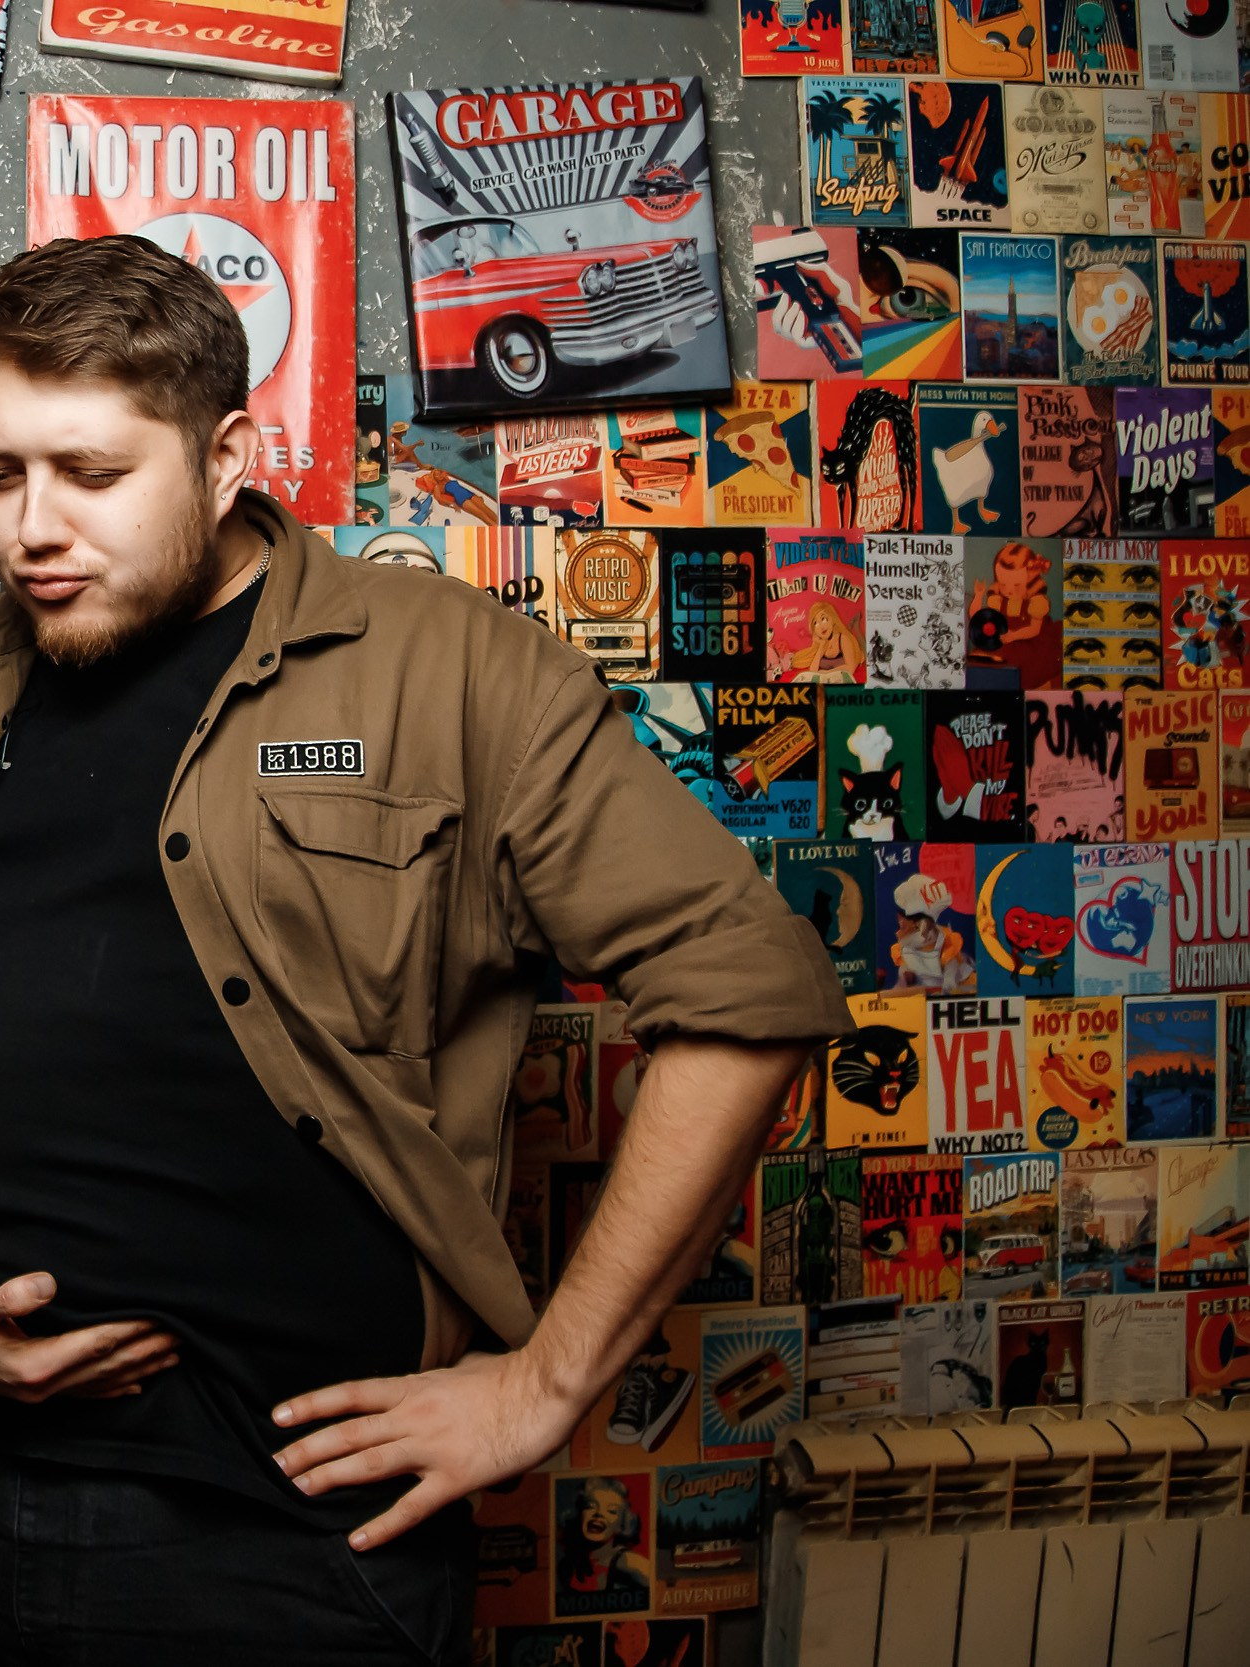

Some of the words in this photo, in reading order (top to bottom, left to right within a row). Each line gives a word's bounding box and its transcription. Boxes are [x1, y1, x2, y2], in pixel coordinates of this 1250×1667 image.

[77, 7, 335, 57] Gasoline
[1050, 72, 1090, 84] WHO
[1097, 73, 1139, 86] WAIT
[442, 86, 676, 145] GARAGE
[50, 122, 236, 200] MOTOR
[255, 127, 336, 202] OIL
[472, 172, 516, 191] SERVICE
[523, 165, 546, 181] CAR
[547, 159, 577, 178] WASH
[584, 152, 612, 168] AUTO
[614, 144, 646, 163] PARTS
[820, 176, 899, 216] Surfing
[937, 209, 991, 222] SPACE
[966, 242, 985, 259] SAN
[989, 241, 1052, 260] FRANCISCO
[1065, 240, 1151, 269] Breakfast
[1170, 363, 1215, 380] PRIVATE
[1222, 363, 1249, 380] TOUR
[920, 390, 943, 400] MESS
[946, 390, 968, 400] WITH
[971, 391, 987, 400] THE
[1117, 405, 1211, 456] Violent
[1131, 450, 1197, 494] Days
[723, 485, 737, 495] FOR
[723, 495, 795, 513] PRESIDENT
[867, 538, 900, 555] Pale
[900, 538, 953, 555] Hands
[585, 558, 630, 579] RETRO
[585, 581, 631, 601] MUSIC
[1177, 663, 1243, 689] Cats
[718, 687, 811, 706] KODAK
[880, 693, 920, 705] CAFE
[718, 708, 776, 726] FILM
[950, 713, 991, 738] PLEASE
[1128, 693, 1214, 741] MUSIC
[962, 724, 1007, 749] DON'T
[268, 747, 285, 770] EST
[290, 745, 355, 769] 1988
[967, 740, 1013, 781] KILL
[782, 800, 811, 814] V620
[789, 816, 810, 830] 620
[932, 1000, 1020, 1029] HELL
[1033, 1012, 1071, 1037] HOT
[1078, 1009, 1118, 1034] DOG
[1135, 1011, 1165, 1024] NEW
[1172, 1009, 1209, 1022] YORK
[934, 1030, 1023, 1132] YEA
[935, 1137, 977, 1154] WHY
[981, 1133, 1023, 1152] NOT?
[1064, 1150, 1096, 1168] LAS
[1099, 1148, 1157, 1166] VEGAS
[864, 1170, 930, 1196] WANT
[935, 1169, 962, 1191] TO
[969, 1162, 1018, 1213] ROAD
[1020, 1158, 1055, 1194] TRIP
[866, 1194, 924, 1220] HURT
[930, 1192, 962, 1215] ME
[710, 1319, 743, 1330] Retro
[747, 1315, 797, 1327] Festival
[661, 1464, 757, 1505] Camping
[558, 1592, 645, 1611] MONROE
[662, 1583, 750, 1604] ADVENTURE
